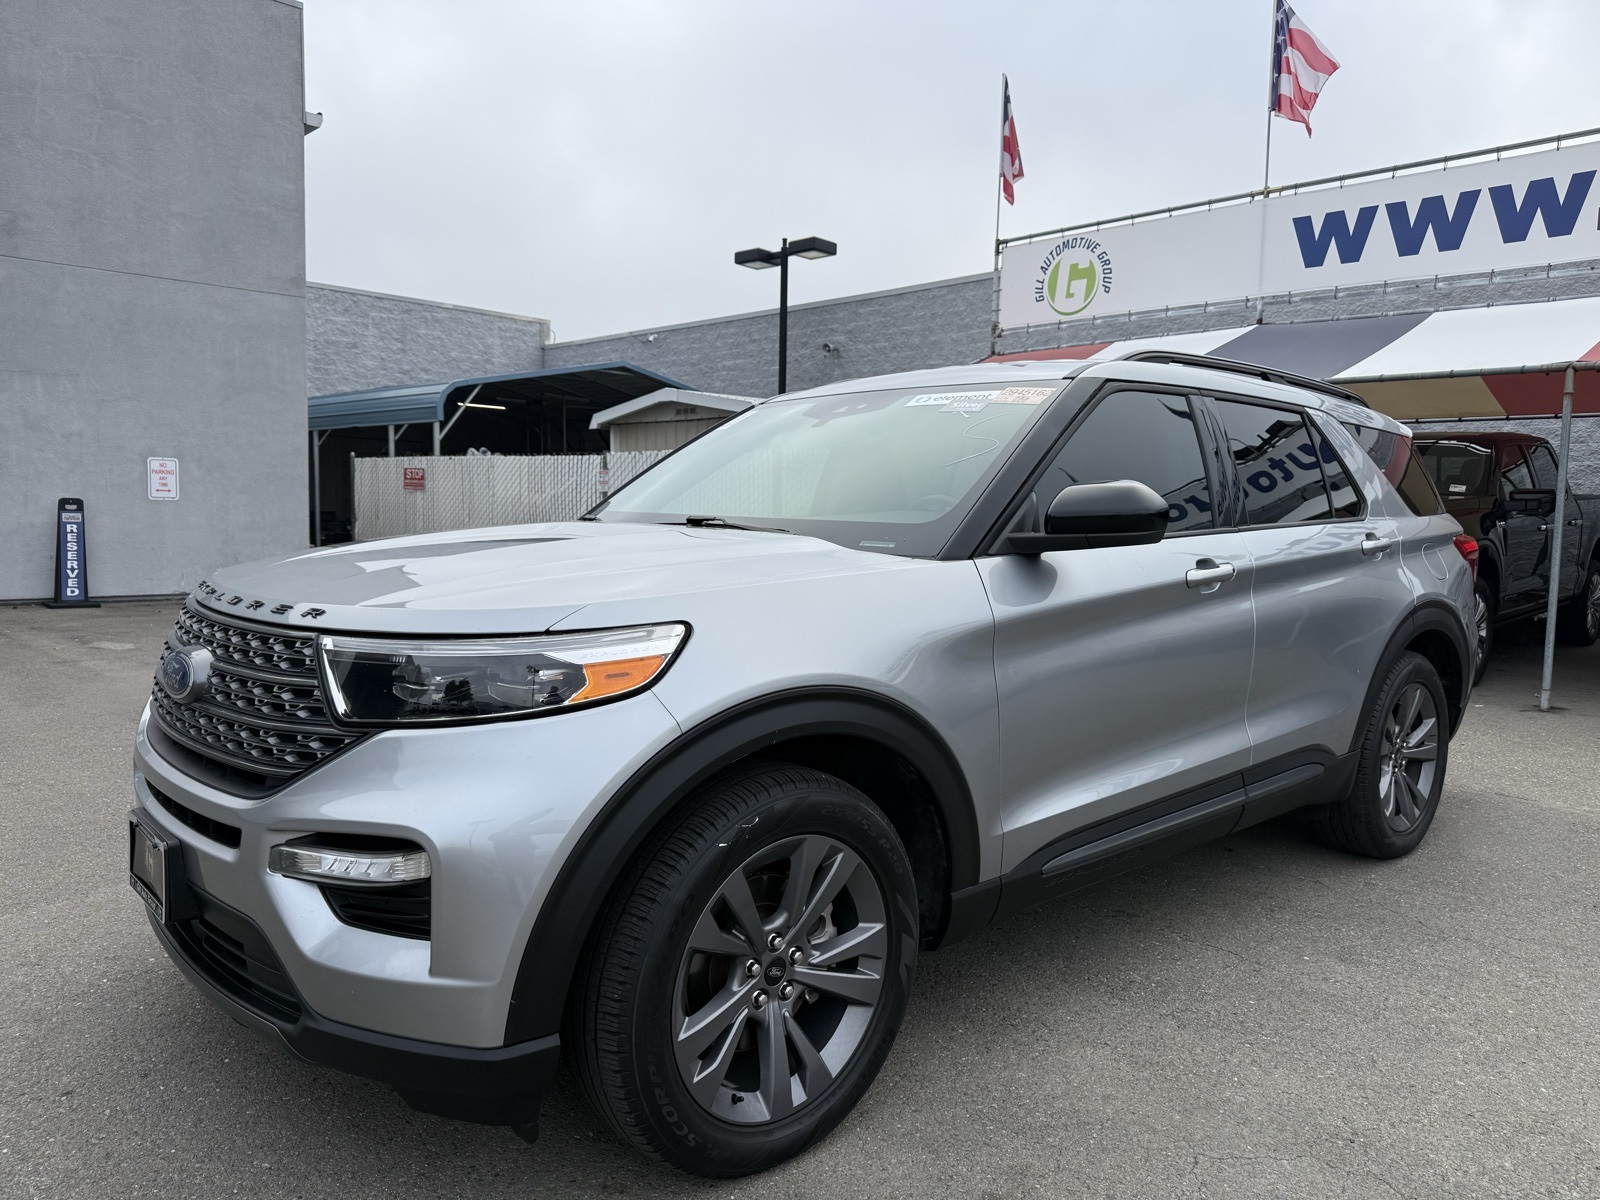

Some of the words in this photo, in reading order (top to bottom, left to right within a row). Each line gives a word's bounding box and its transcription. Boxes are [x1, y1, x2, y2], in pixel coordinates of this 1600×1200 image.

[1035, 278, 1045, 302] GILL
[1040, 237, 1101, 275] AUTOMOTIVE
[1097, 251, 1112, 294] GROUP
[933, 393, 992, 401] element
[406, 469, 424, 479] STOP
[66, 524, 79, 596] RESERVED
